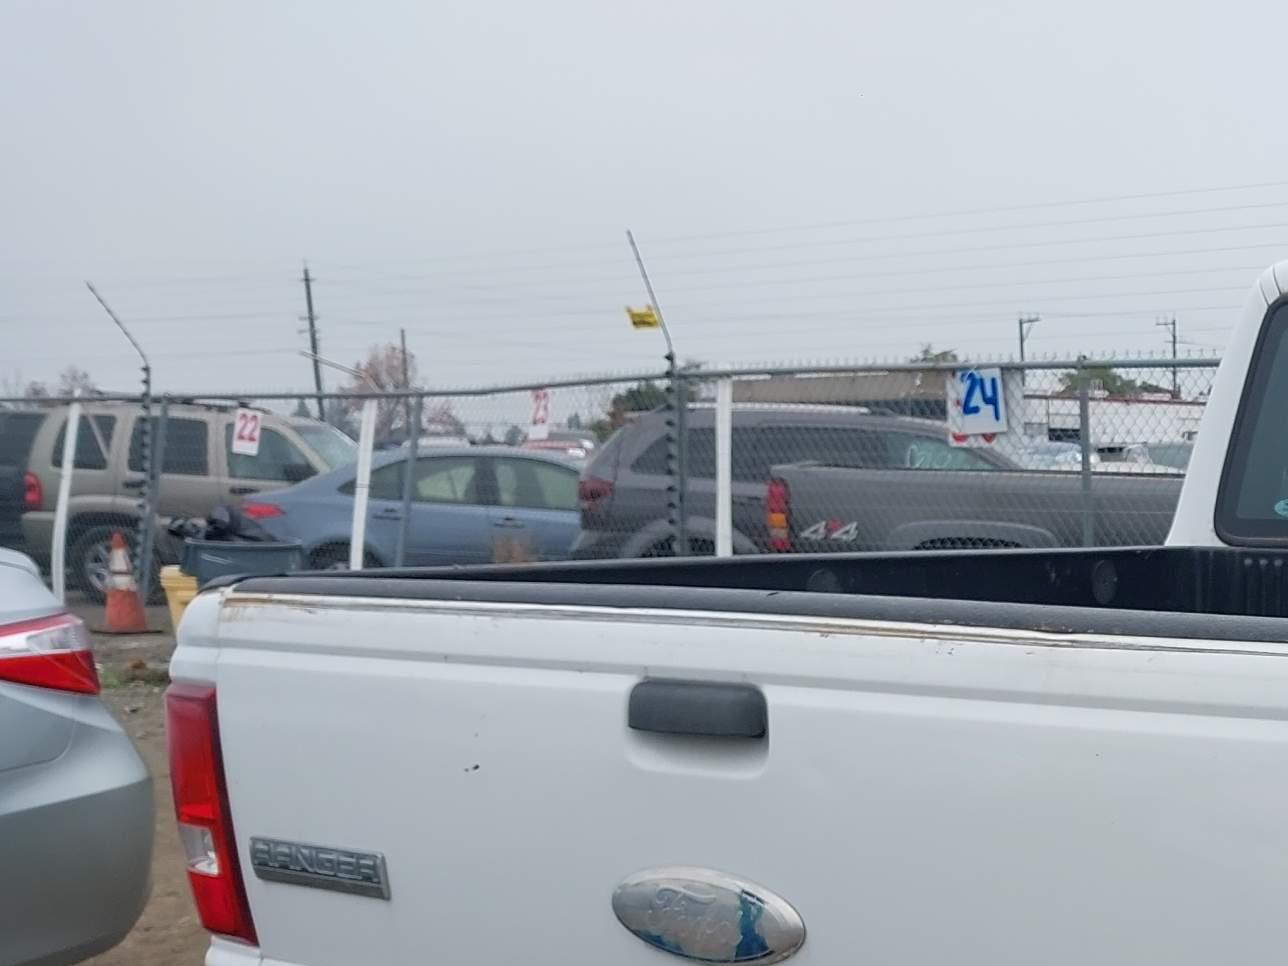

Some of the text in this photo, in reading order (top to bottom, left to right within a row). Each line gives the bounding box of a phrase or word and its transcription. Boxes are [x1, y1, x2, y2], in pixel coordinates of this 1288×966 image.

[960, 371, 1000, 421] 24
[237, 412, 258, 442] 22
[252, 840, 382, 883] RANGER
